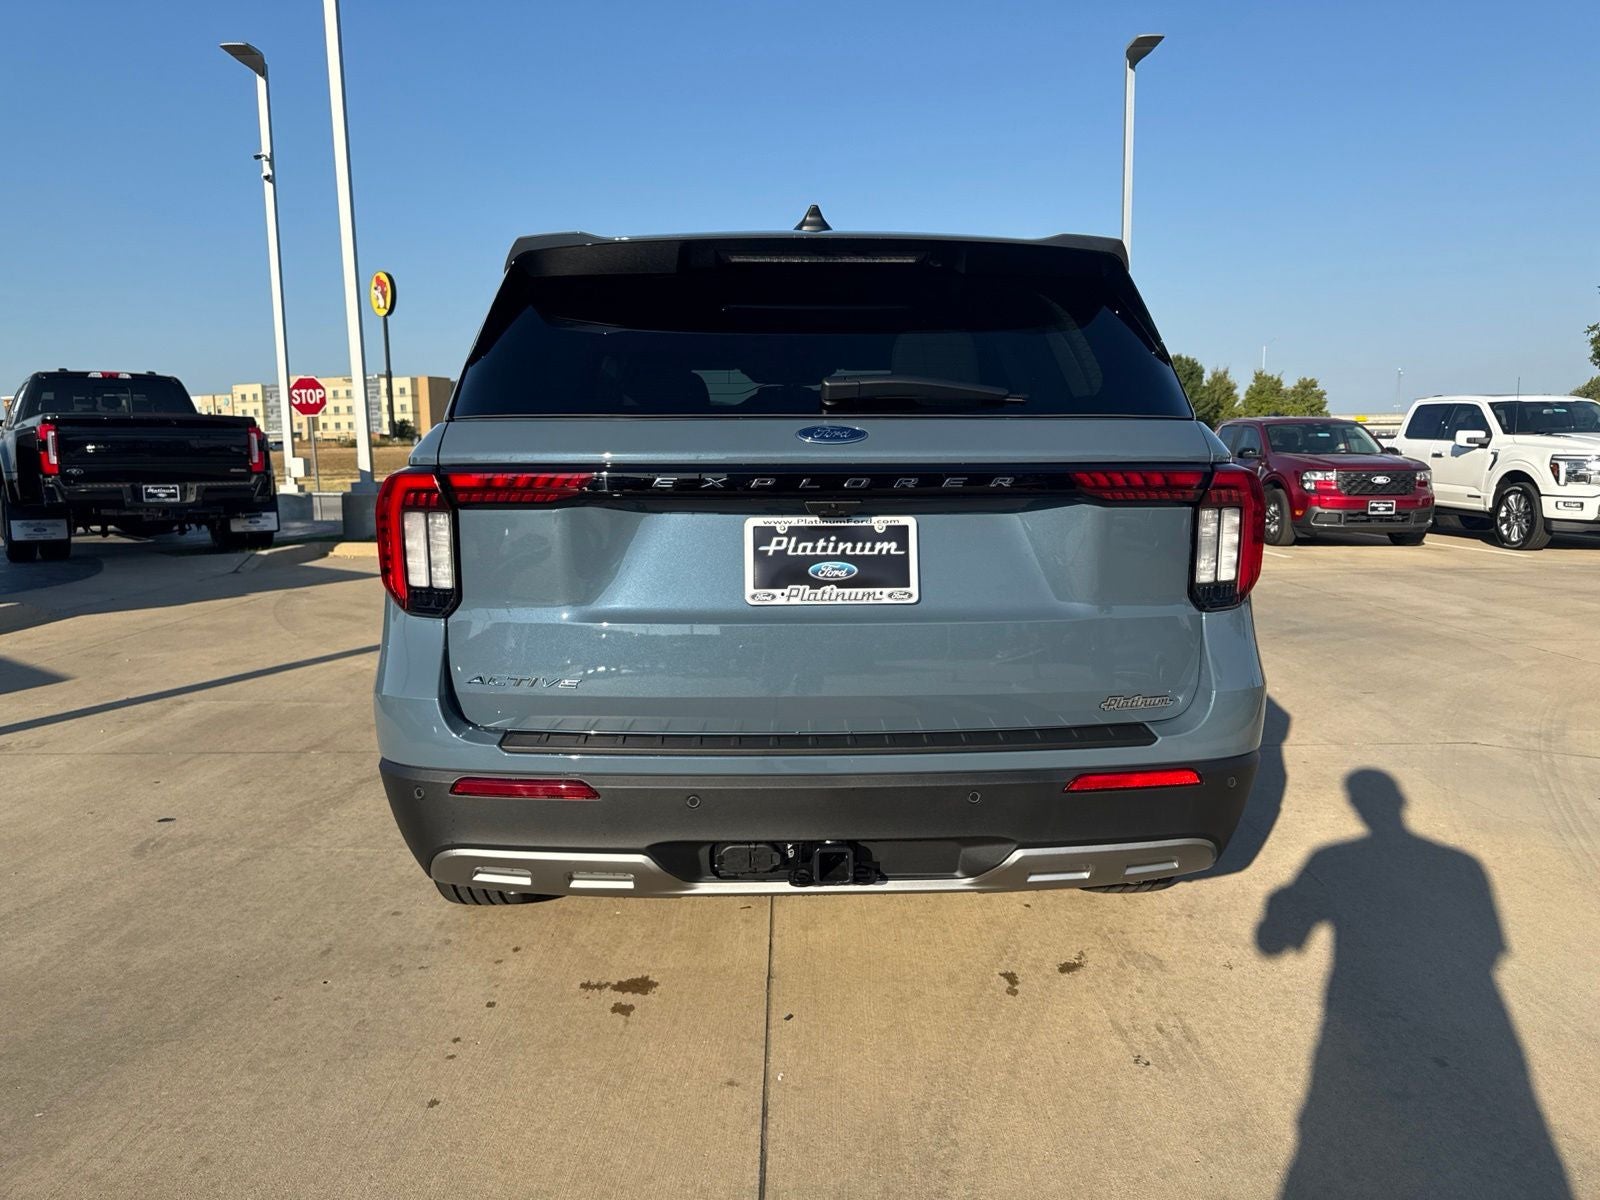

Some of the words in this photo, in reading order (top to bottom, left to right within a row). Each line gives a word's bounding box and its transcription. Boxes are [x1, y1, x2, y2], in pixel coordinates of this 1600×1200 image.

[291, 389, 325, 405] STOP
[652, 476, 1016, 490] EXPLORER
[758, 535, 905, 556] Platinum
[786, 586, 883, 602] Platinum
[465, 675, 583, 689] ACTIVE
[1099, 694, 1174, 711] Platinum
